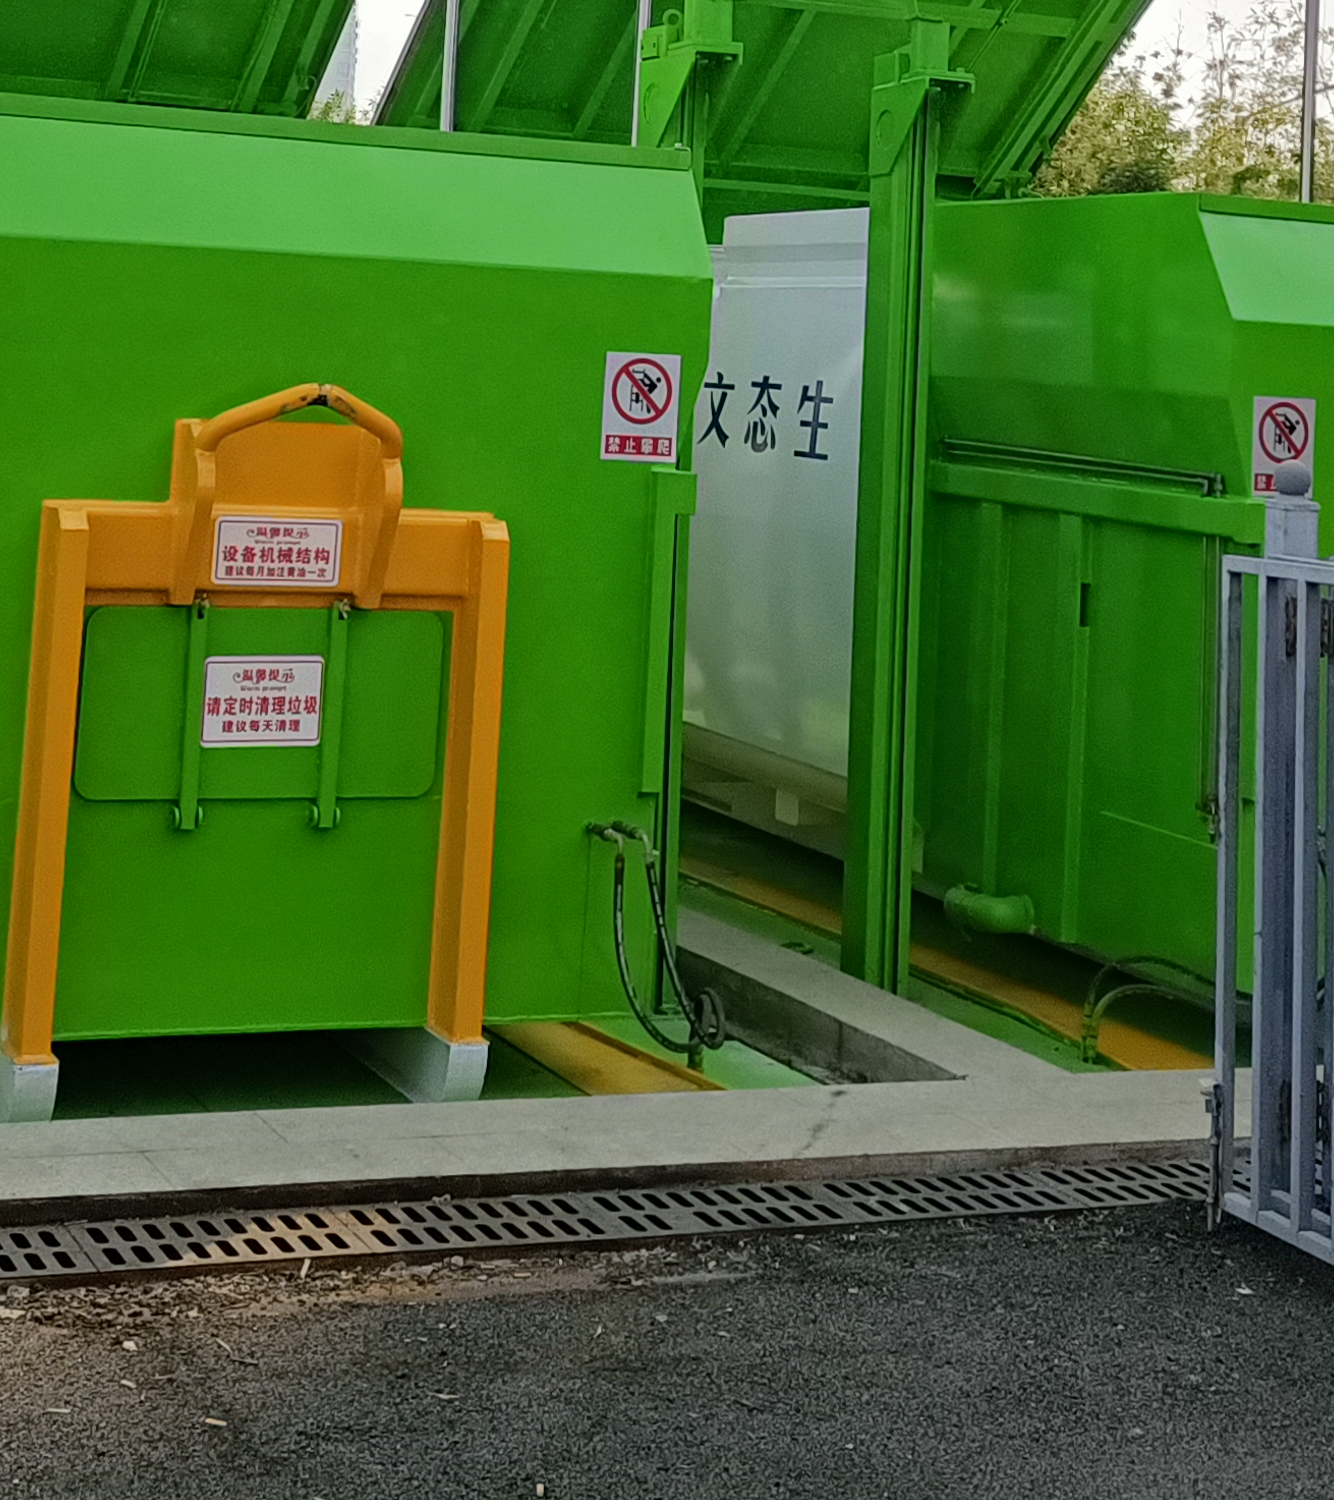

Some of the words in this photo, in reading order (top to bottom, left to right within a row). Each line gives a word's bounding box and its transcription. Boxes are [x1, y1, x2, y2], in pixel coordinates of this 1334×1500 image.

[608, 436, 670, 455] 禁止攀爬
[222, 545, 330, 565] 设备机械结构
[225, 565, 327, 578] 建议每月加注黄油一次
[207, 695, 318, 716] 请定时清理垃圾
[222, 719, 300, 733] 建议每天清理
